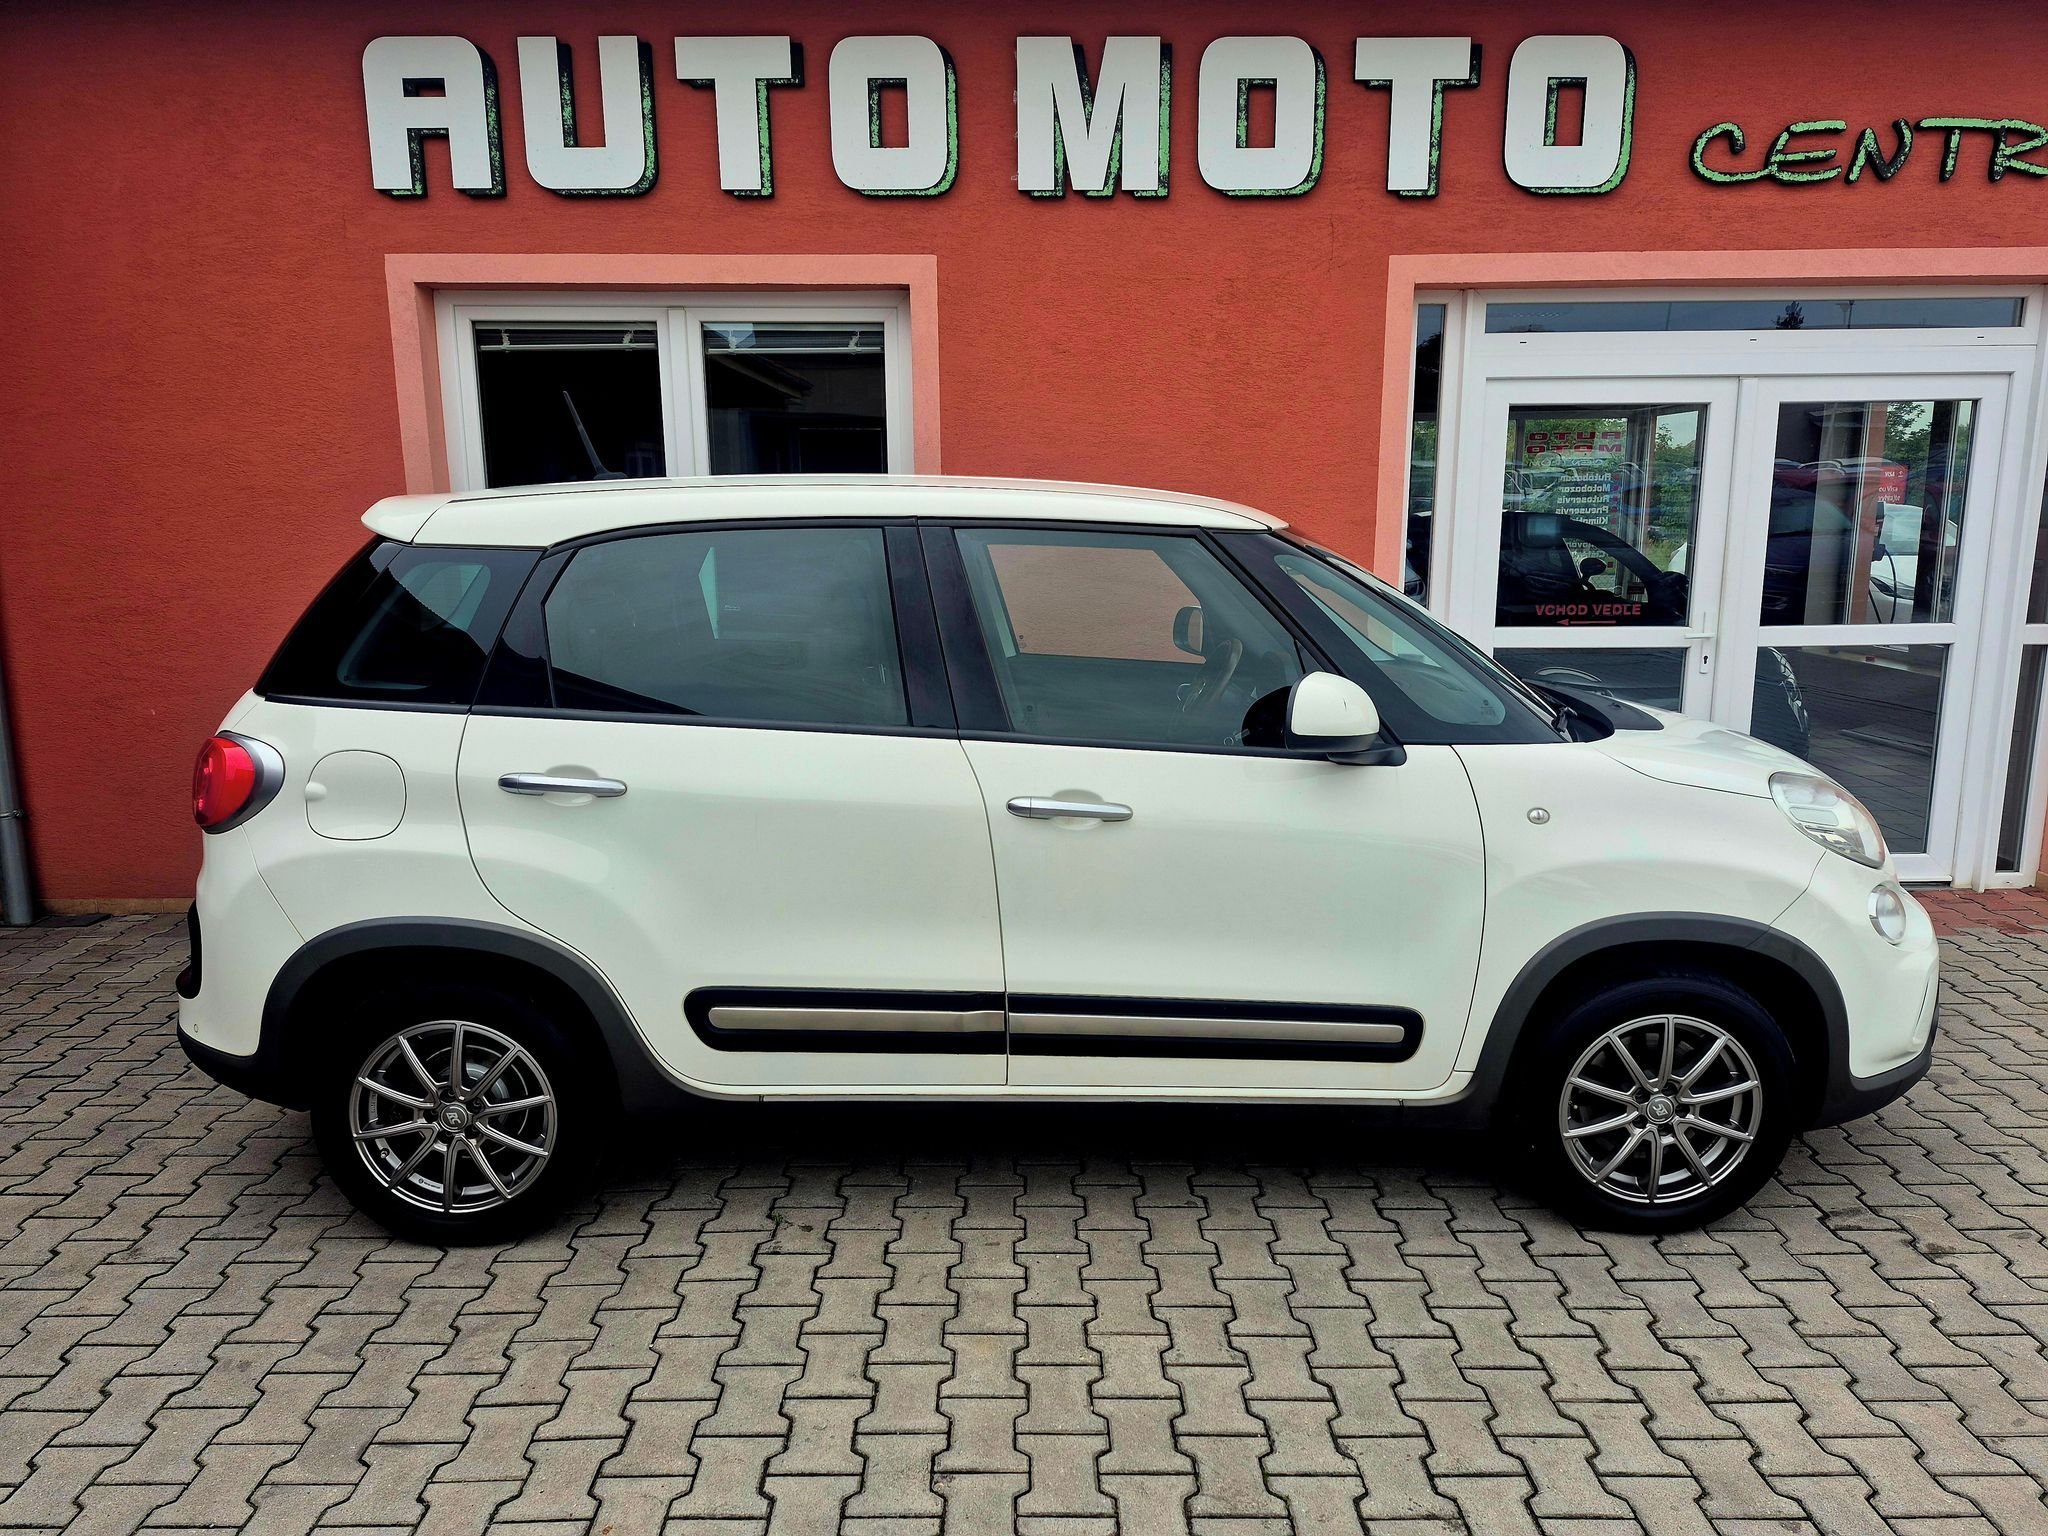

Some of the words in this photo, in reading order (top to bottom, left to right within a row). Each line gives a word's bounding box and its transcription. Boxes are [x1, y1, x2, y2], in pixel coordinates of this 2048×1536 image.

[362, 35, 957, 198] AUTO
[1015, 34, 1637, 198] MOTO
[1689, 117, 2048, 185] CENTR
[1535, 604, 1588, 616] VCHOD
[1592, 604, 1642, 616] VEDLE
